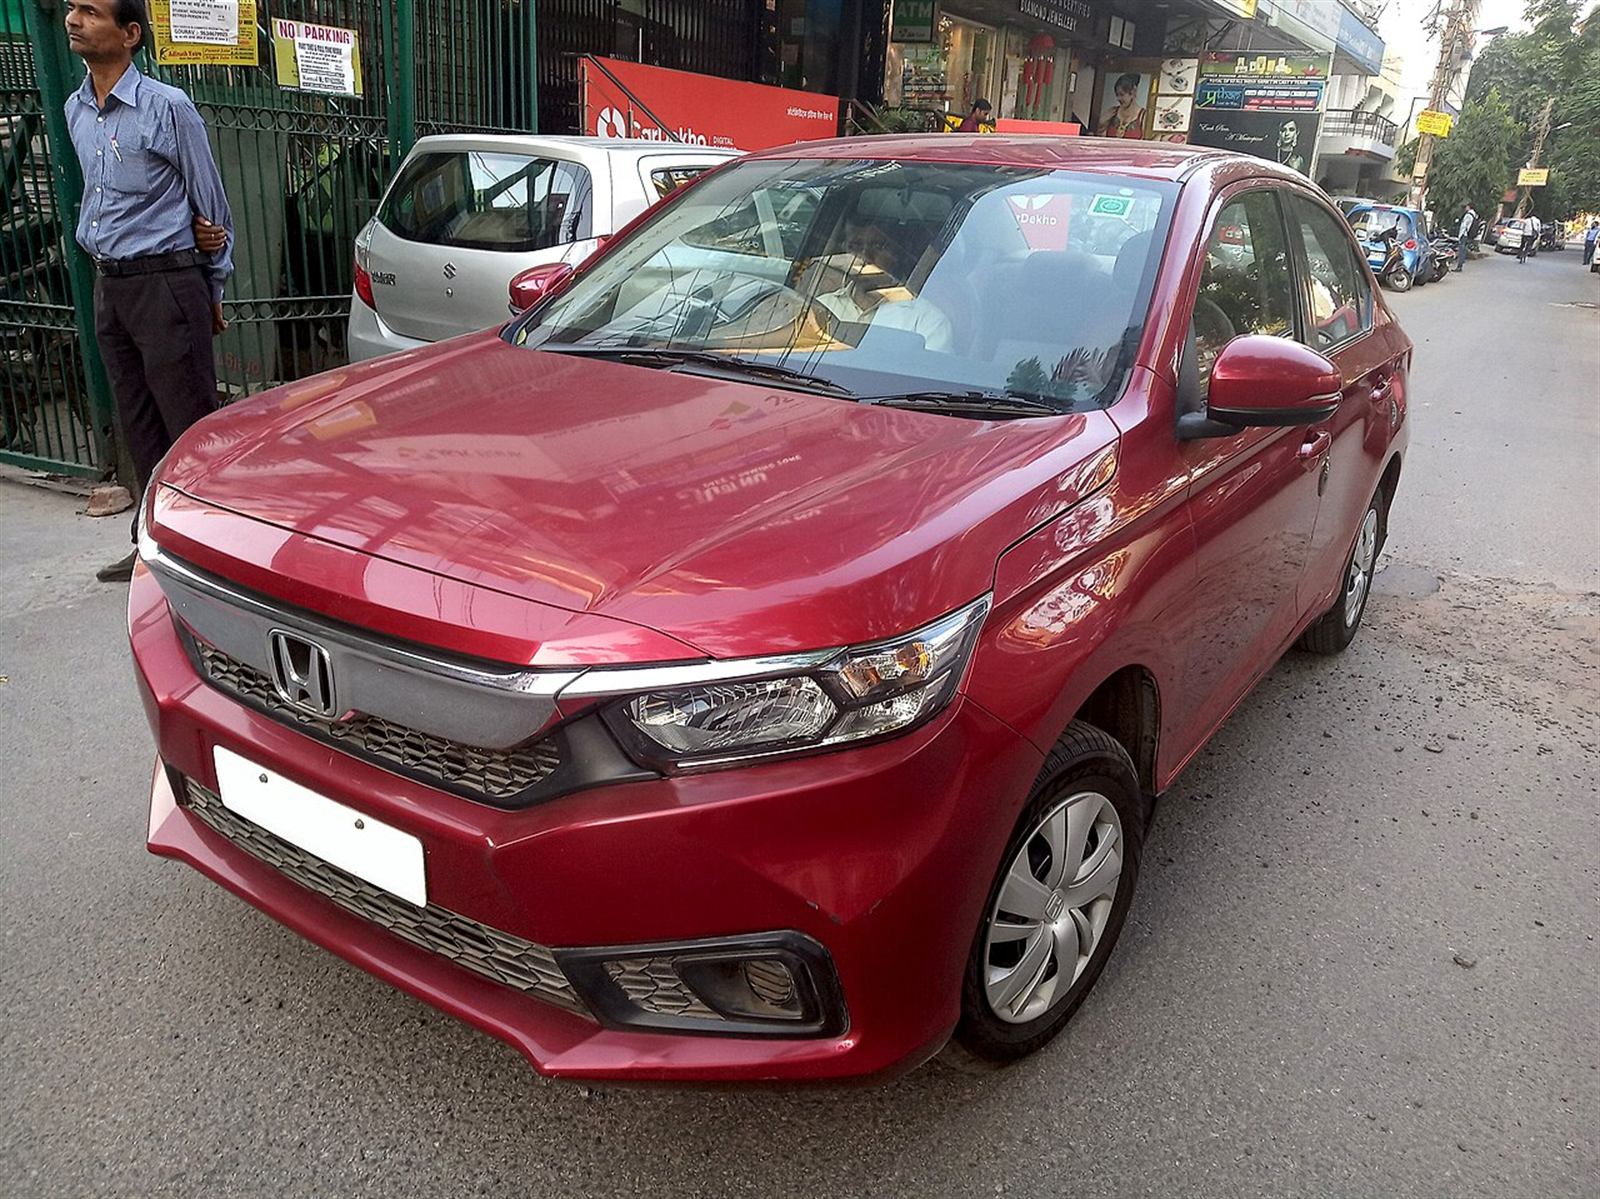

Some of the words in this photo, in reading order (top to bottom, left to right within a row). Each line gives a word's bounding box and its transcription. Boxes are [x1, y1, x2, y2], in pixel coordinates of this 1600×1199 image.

[896, 1, 932, 18] ATM
[1046, 9, 1077, 32] JEWELLERY
[279, 21, 295, 39] NO
[304, 25, 350, 44] PARKING
[713, 135, 734, 146] DIGITAL
